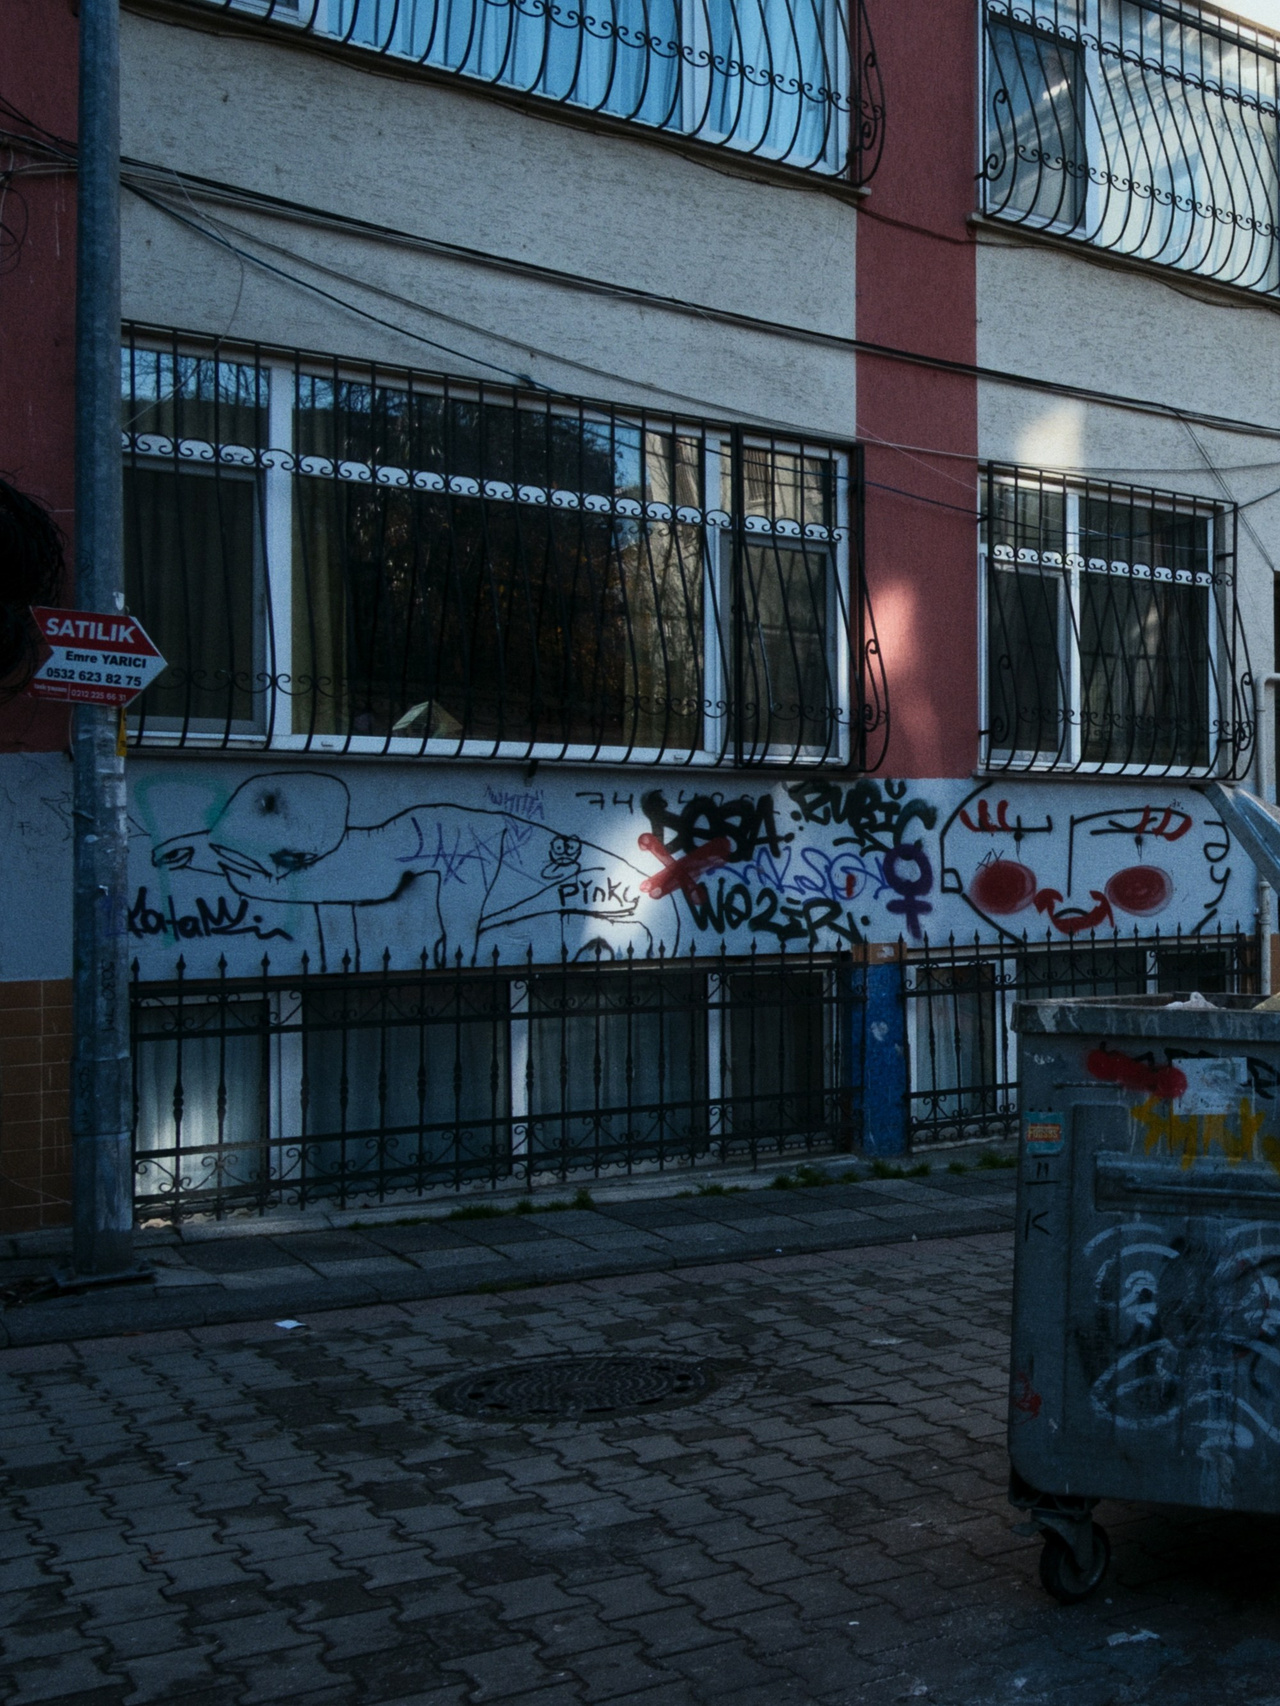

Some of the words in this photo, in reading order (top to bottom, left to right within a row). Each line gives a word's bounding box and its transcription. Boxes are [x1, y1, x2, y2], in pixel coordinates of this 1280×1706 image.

[45, 617, 136, 644] SATILIK
[65, 650, 98, 664] Emre
[101, 654, 147, 669] YARICI
[46, 667, 76, 680] 0532
[78, 670, 102, 682] 623
[105, 673, 121, 685] 82
[125, 675, 142, 687] 75
[71, 689, 89, 699] 0212
[91, 691, 105, 700] 225
